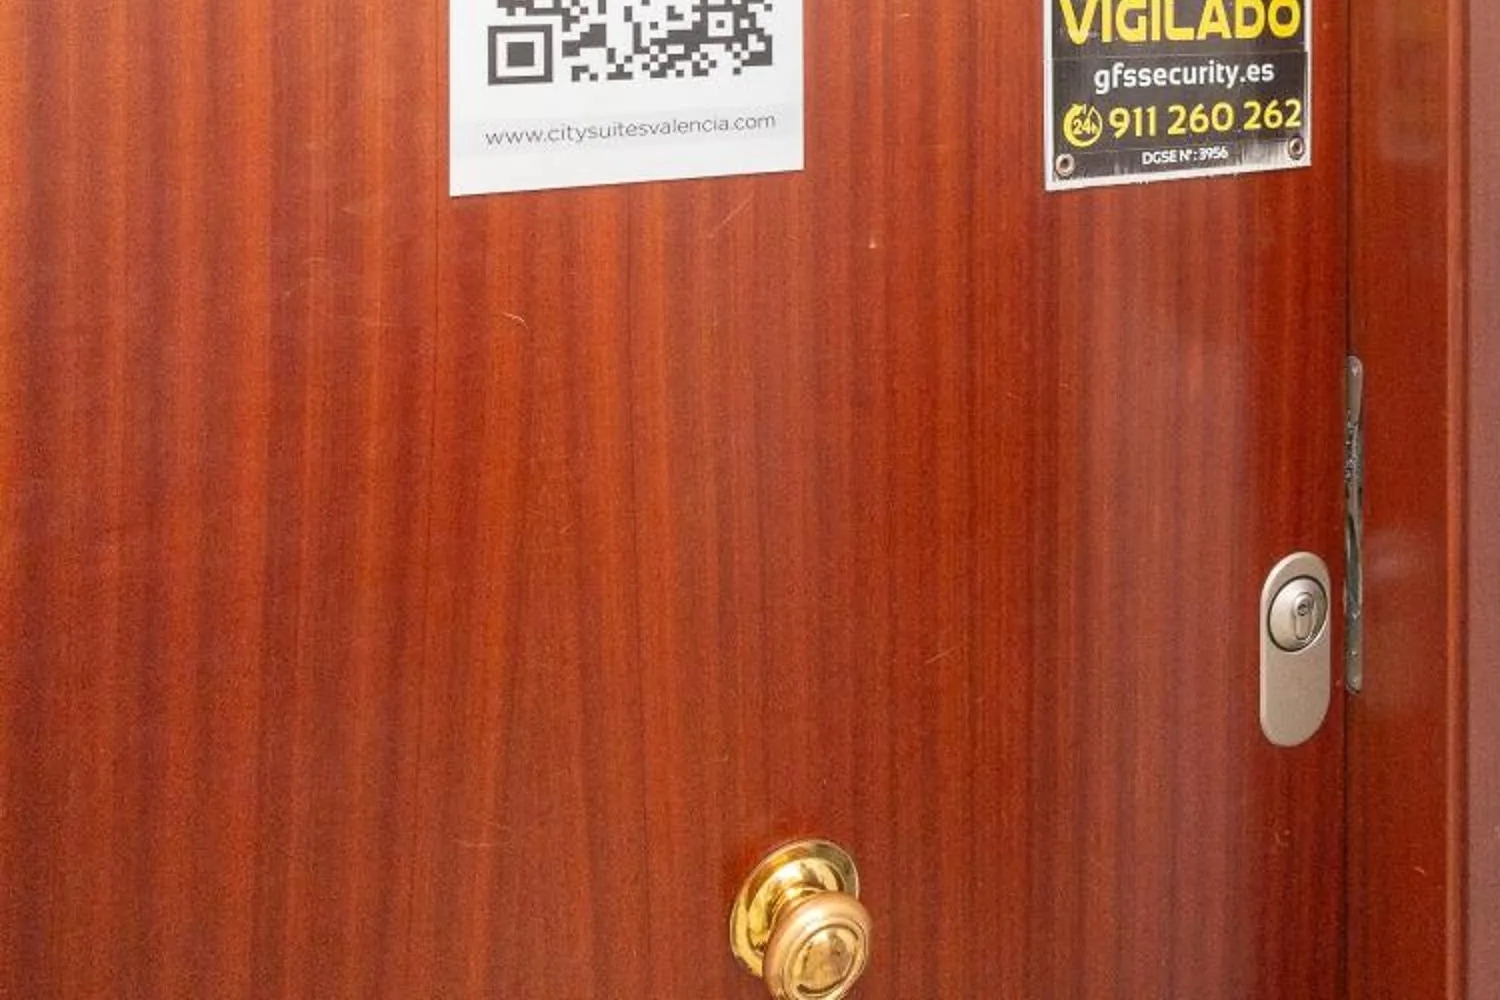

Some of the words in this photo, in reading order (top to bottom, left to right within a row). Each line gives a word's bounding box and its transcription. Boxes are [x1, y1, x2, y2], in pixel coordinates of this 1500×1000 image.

[1094, 60, 1275, 95] gfssecurity.es
[484, 112, 777, 149] www.citysuitesvalencia.com
[1108, 105, 1157, 138] 911
[1167, 102, 1234, 136] 260
[1243, 99, 1302, 131] 262
[1141, 151, 1177, 165] DGSE
